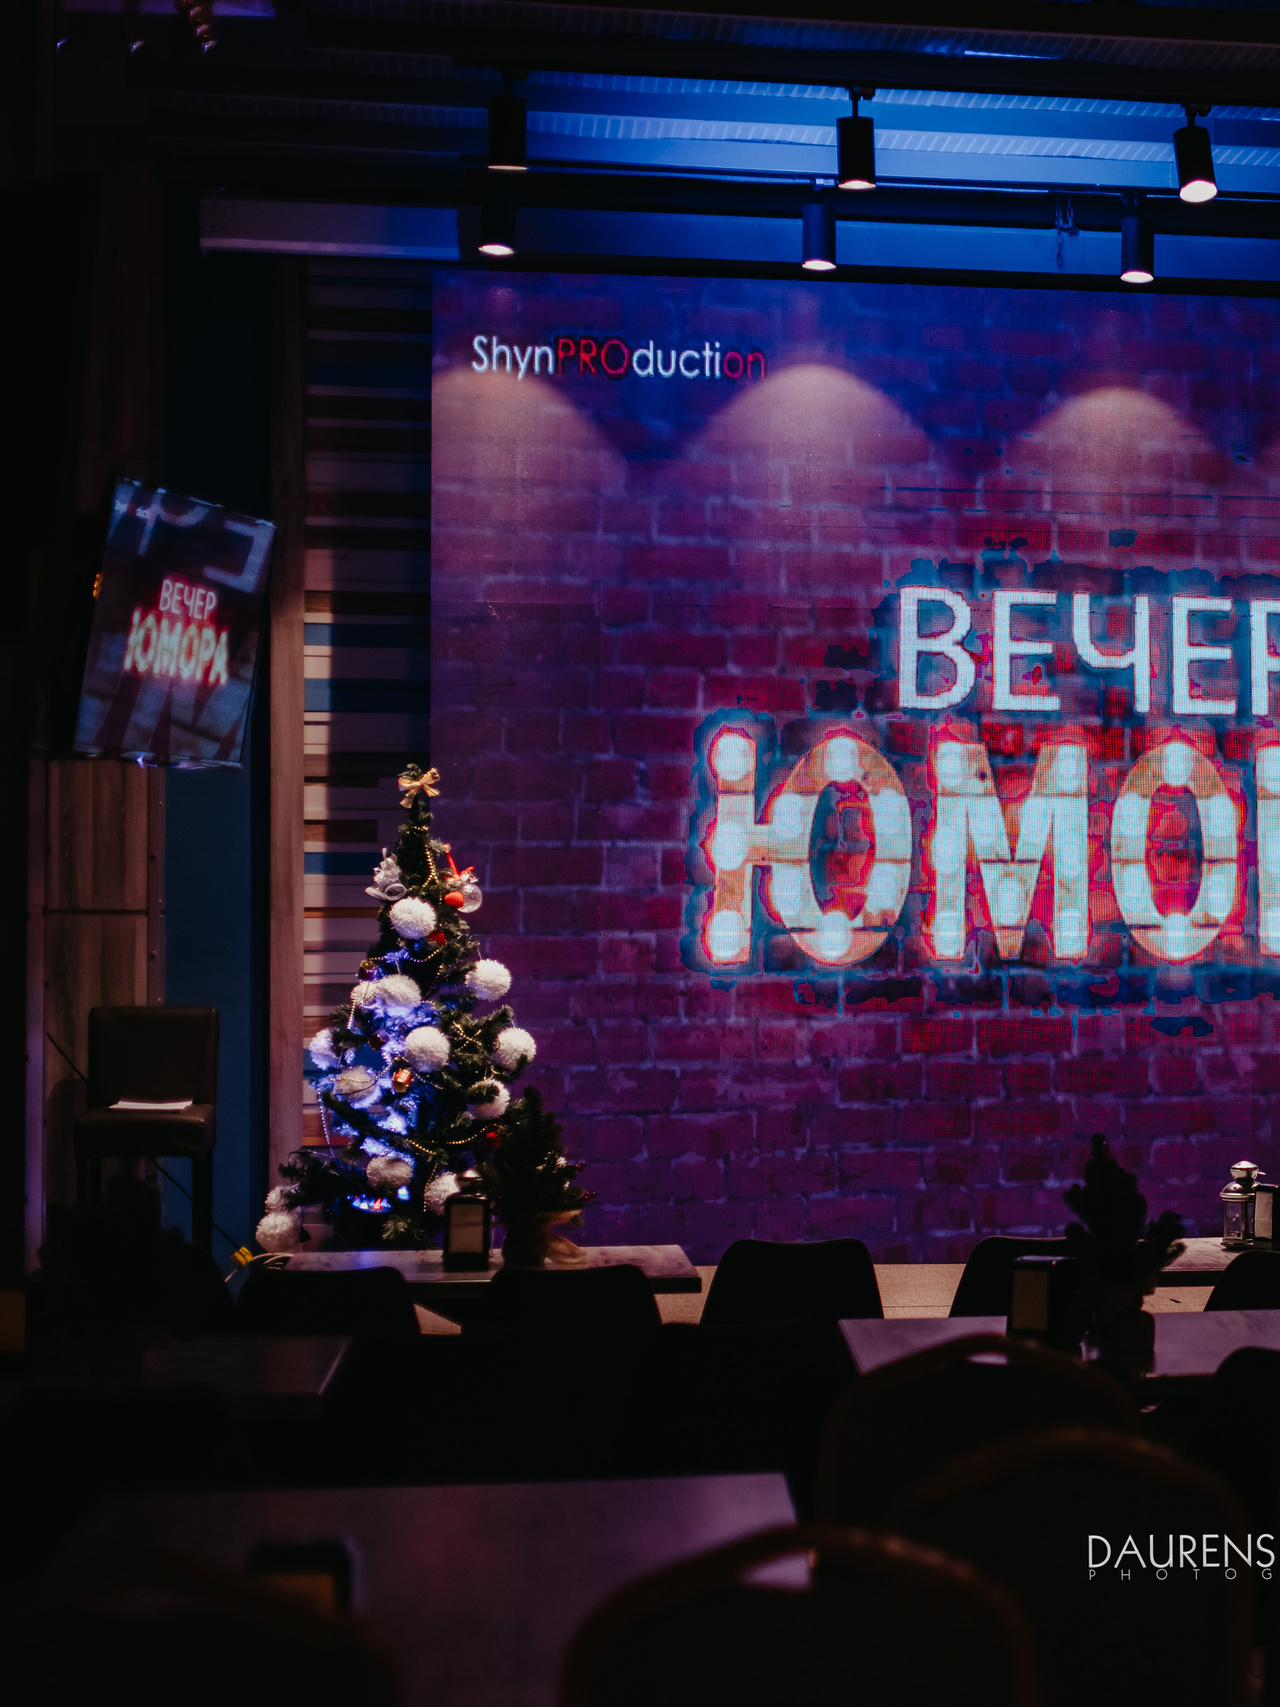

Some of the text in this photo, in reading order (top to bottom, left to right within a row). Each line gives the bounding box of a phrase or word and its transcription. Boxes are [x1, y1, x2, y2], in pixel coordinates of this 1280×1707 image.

[471, 335, 766, 380] ShynPROduction
[158, 579, 218, 620] ВЕЧЕР
[123, 607, 229, 684] ЮМОРА
